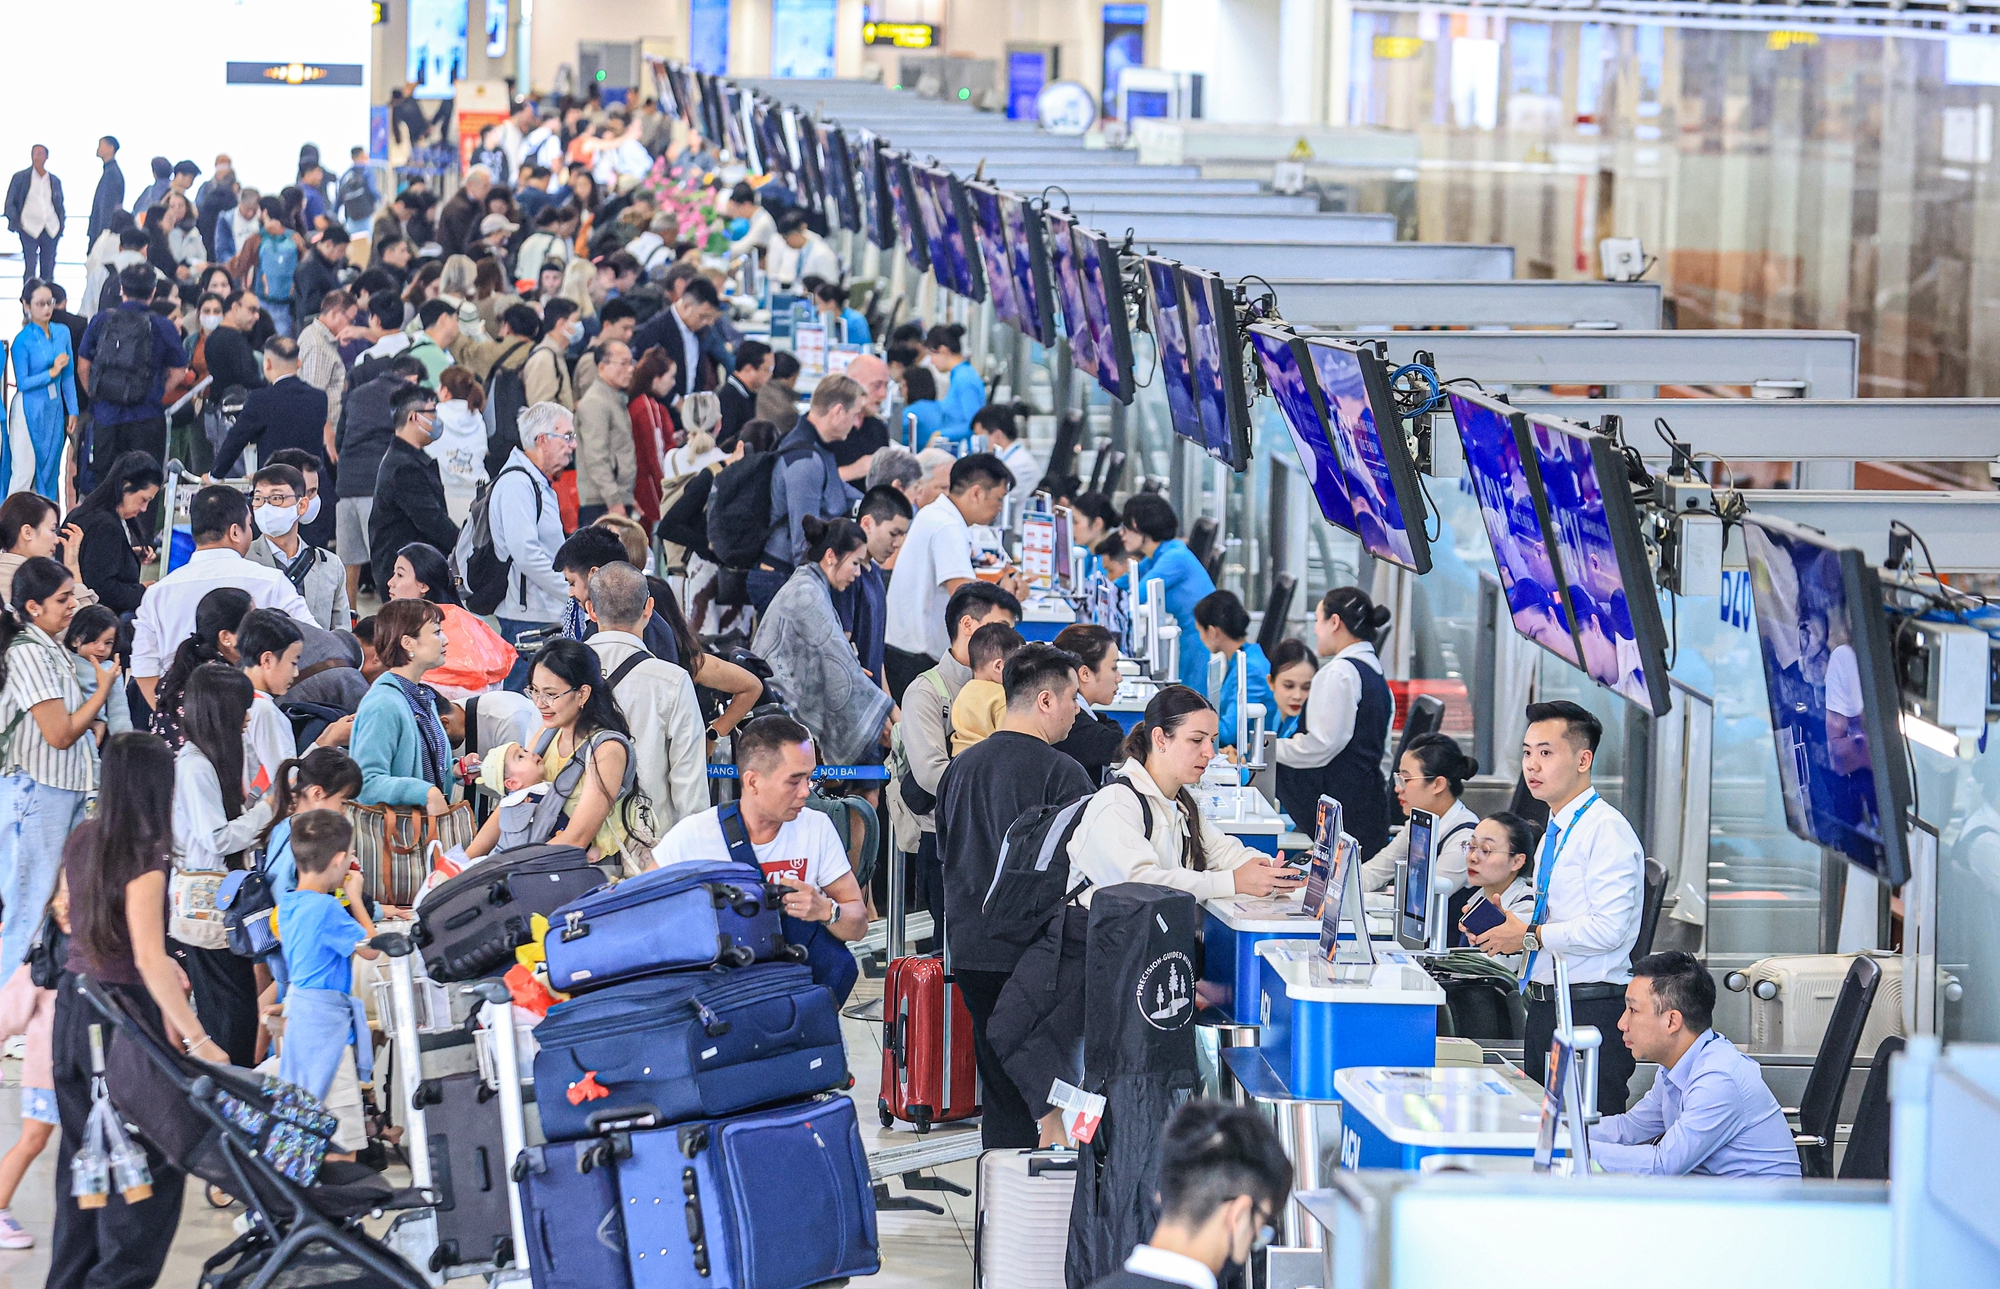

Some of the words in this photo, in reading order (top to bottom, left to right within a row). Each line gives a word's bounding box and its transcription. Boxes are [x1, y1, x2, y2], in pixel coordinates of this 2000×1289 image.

[1136, 950, 1183, 997] PRECISION-GUIDED
[1260, 988, 1272, 1031] ACV
[1340, 1123, 1362, 1174] ACV
